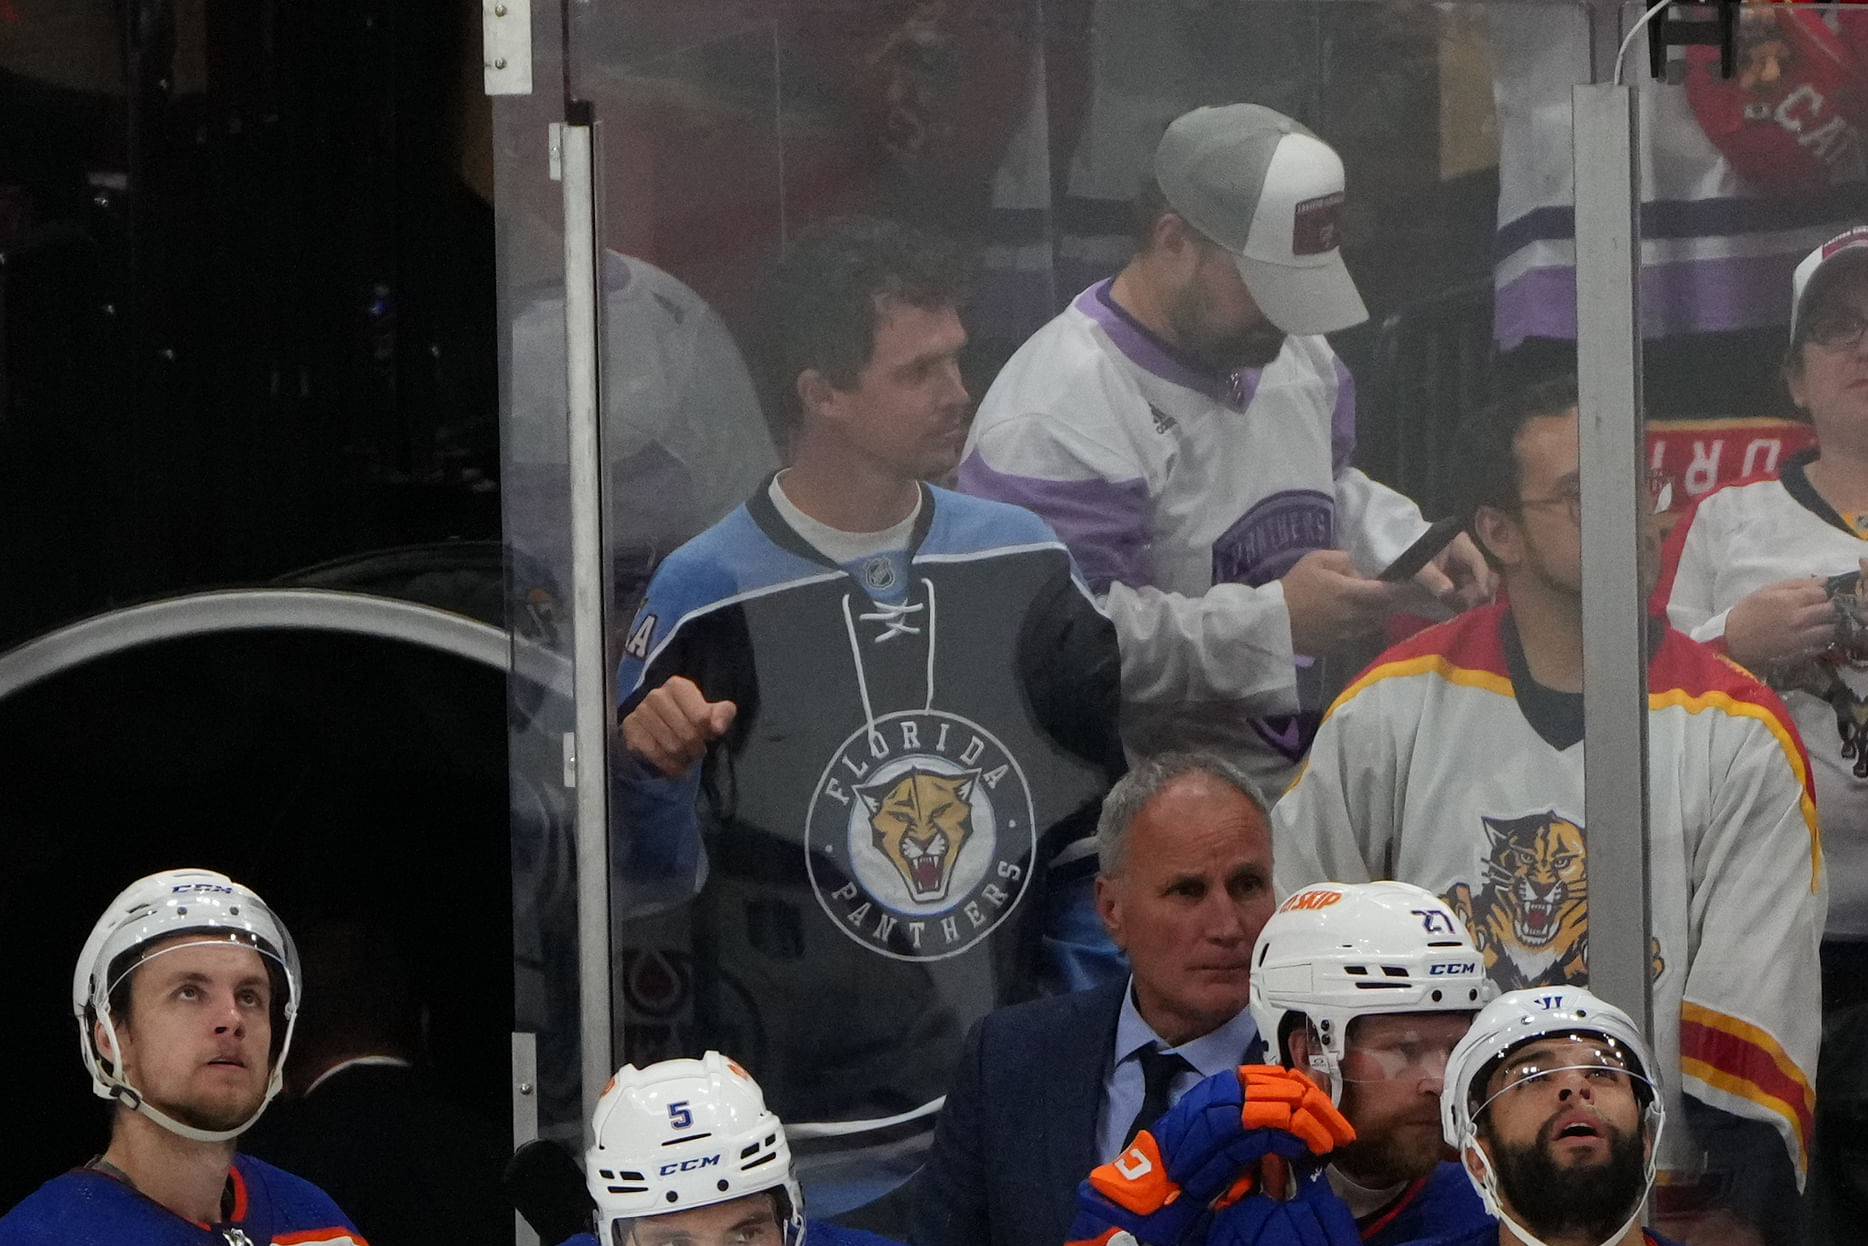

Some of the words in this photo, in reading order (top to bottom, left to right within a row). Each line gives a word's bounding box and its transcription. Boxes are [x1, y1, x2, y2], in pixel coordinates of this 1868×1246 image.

[825, 720, 1009, 806] FLORIDA
[831, 860, 1021, 948] PANTHERS
[1429, 962, 1476, 976] CCM
[668, 1100, 695, 1130] 5
[659, 1154, 721, 1177] CCM
